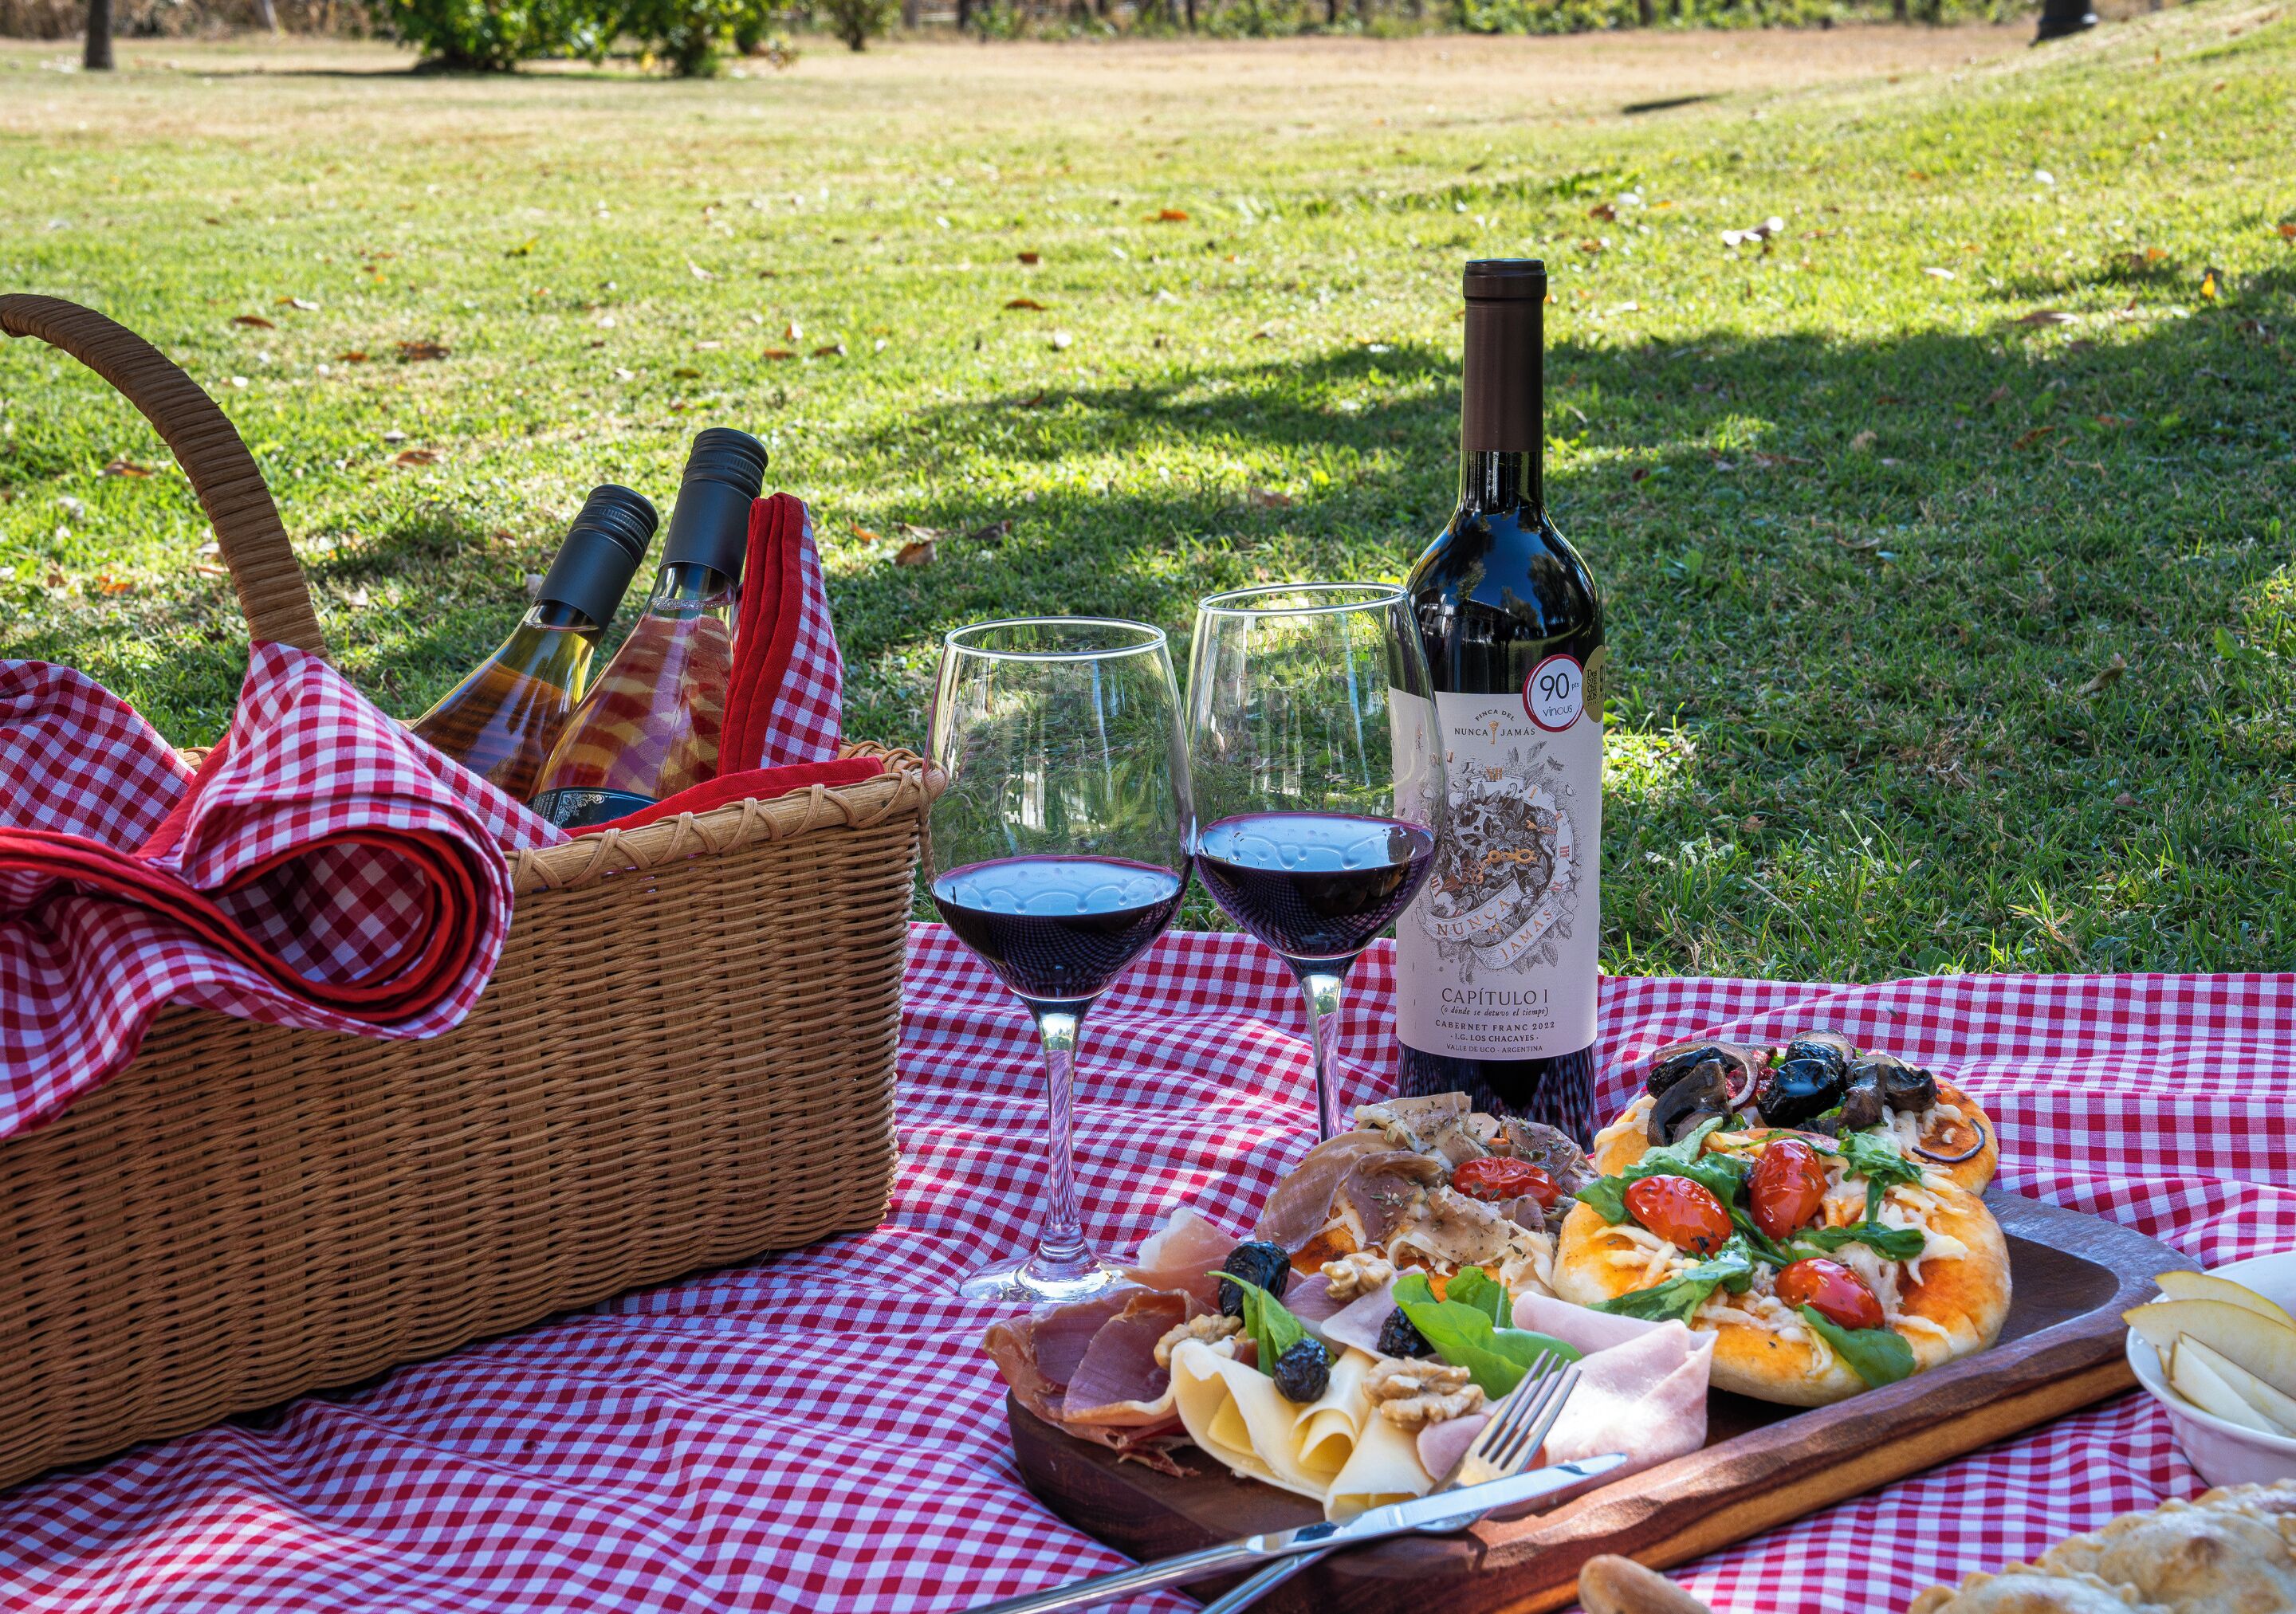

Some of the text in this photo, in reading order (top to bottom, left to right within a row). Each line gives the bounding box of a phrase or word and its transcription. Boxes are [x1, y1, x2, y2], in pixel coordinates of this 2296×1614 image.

[1540, 673, 1569, 701] 90
[1475, 709, 1515, 721] FINCA DEL
[1543, 705, 1573, 717] vinous
[1454, 725, 1535, 736] NUNCA JAMÁS
[1437, 898, 1512, 937] NUNCA
[1500, 909, 1553, 960] JAMÁS
[1441, 988, 1547, 1006] CAPÍTULO I
[1450, 1006, 1471, 1015] dónde
[1484, 1007, 1509, 1016] detuvo
[1512, 1007, 1520, 1016] el
[1522, 1006, 1549, 1017] tiempo)
[1435, 1019, 1555, 1032] CABERNET FRANC 2022
[1488, 1034, 1535, 1043] CHACAYES
[1446, 1043, 1467, 1051] VALLE
[1501, 1045, 1543, 1054] ARGENTINA
